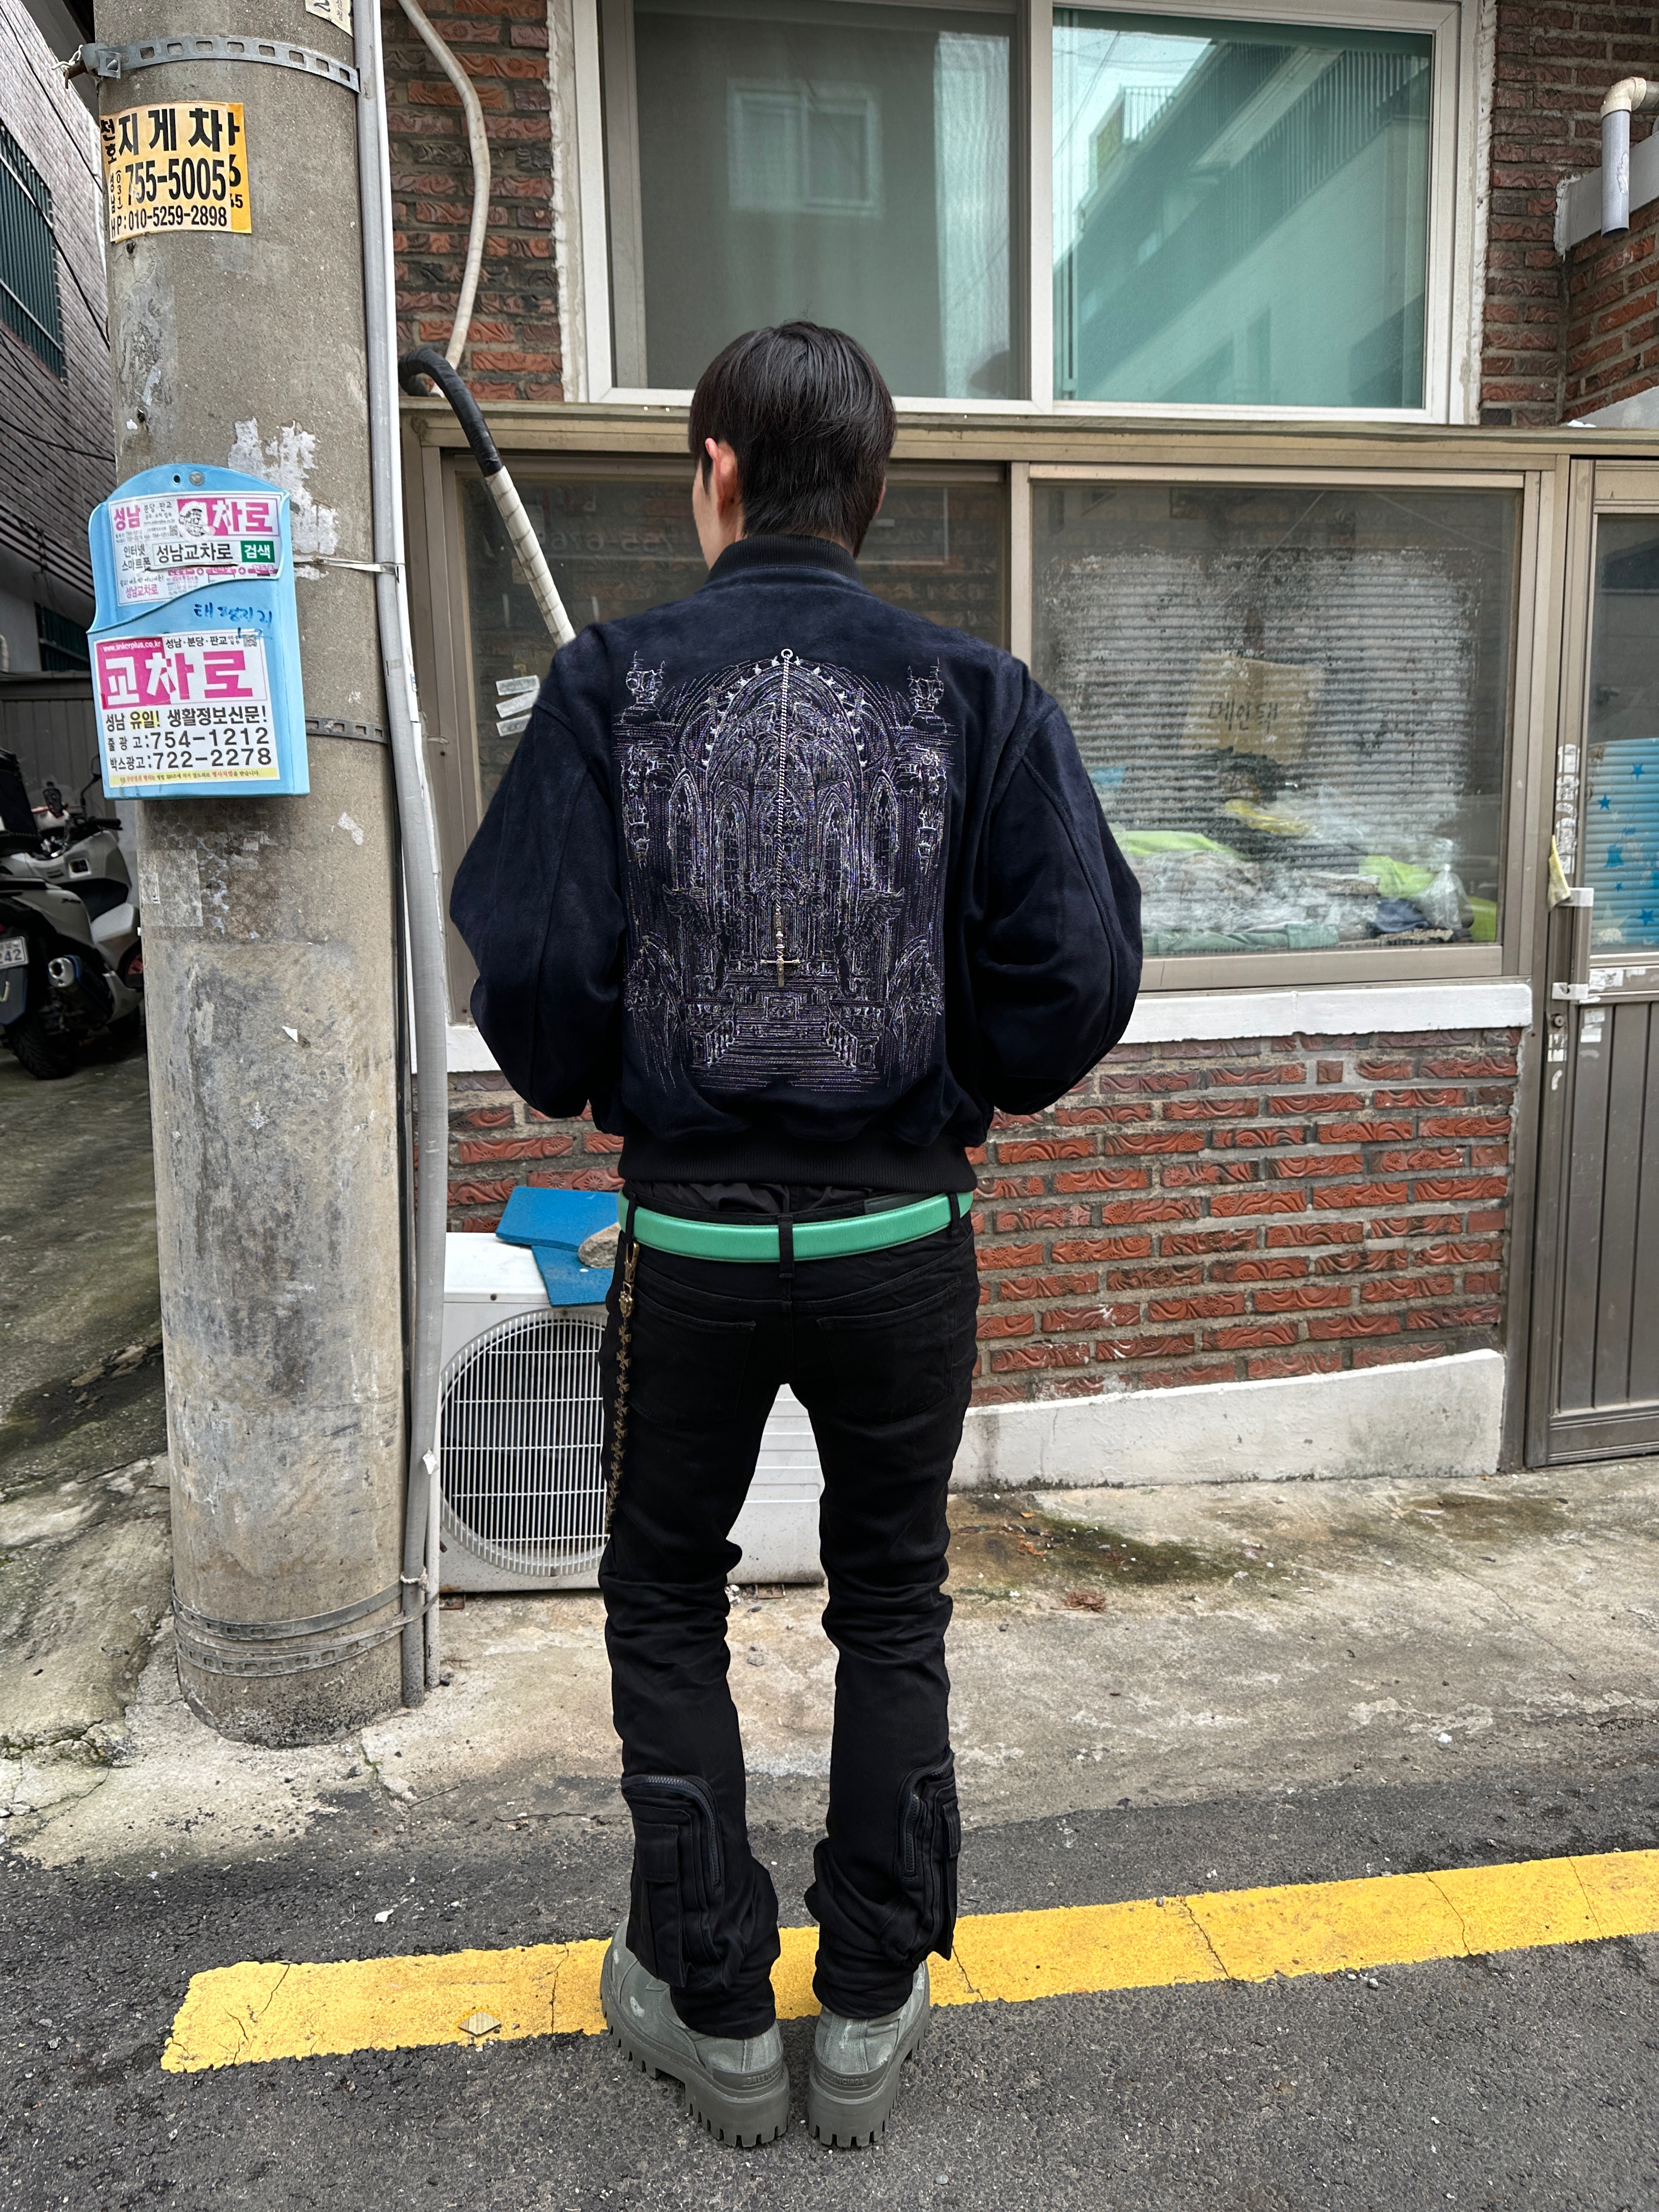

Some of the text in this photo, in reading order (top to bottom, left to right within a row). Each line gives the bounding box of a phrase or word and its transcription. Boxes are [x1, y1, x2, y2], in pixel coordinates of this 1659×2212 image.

[125, 157, 226, 205] 755-5005
[114, 505, 140, 531] 성남
[184, 500, 273, 532] 차로
[122, 557, 151, 571] 스마트폰
[124, 543, 270, 563] 인터넷 성남교차로 검색
[126, 584, 159, 599] 성남교차로
[105, 650, 253, 706] 교차로
[106, 706, 267, 732] 성남 유일! 생활정보신문!
